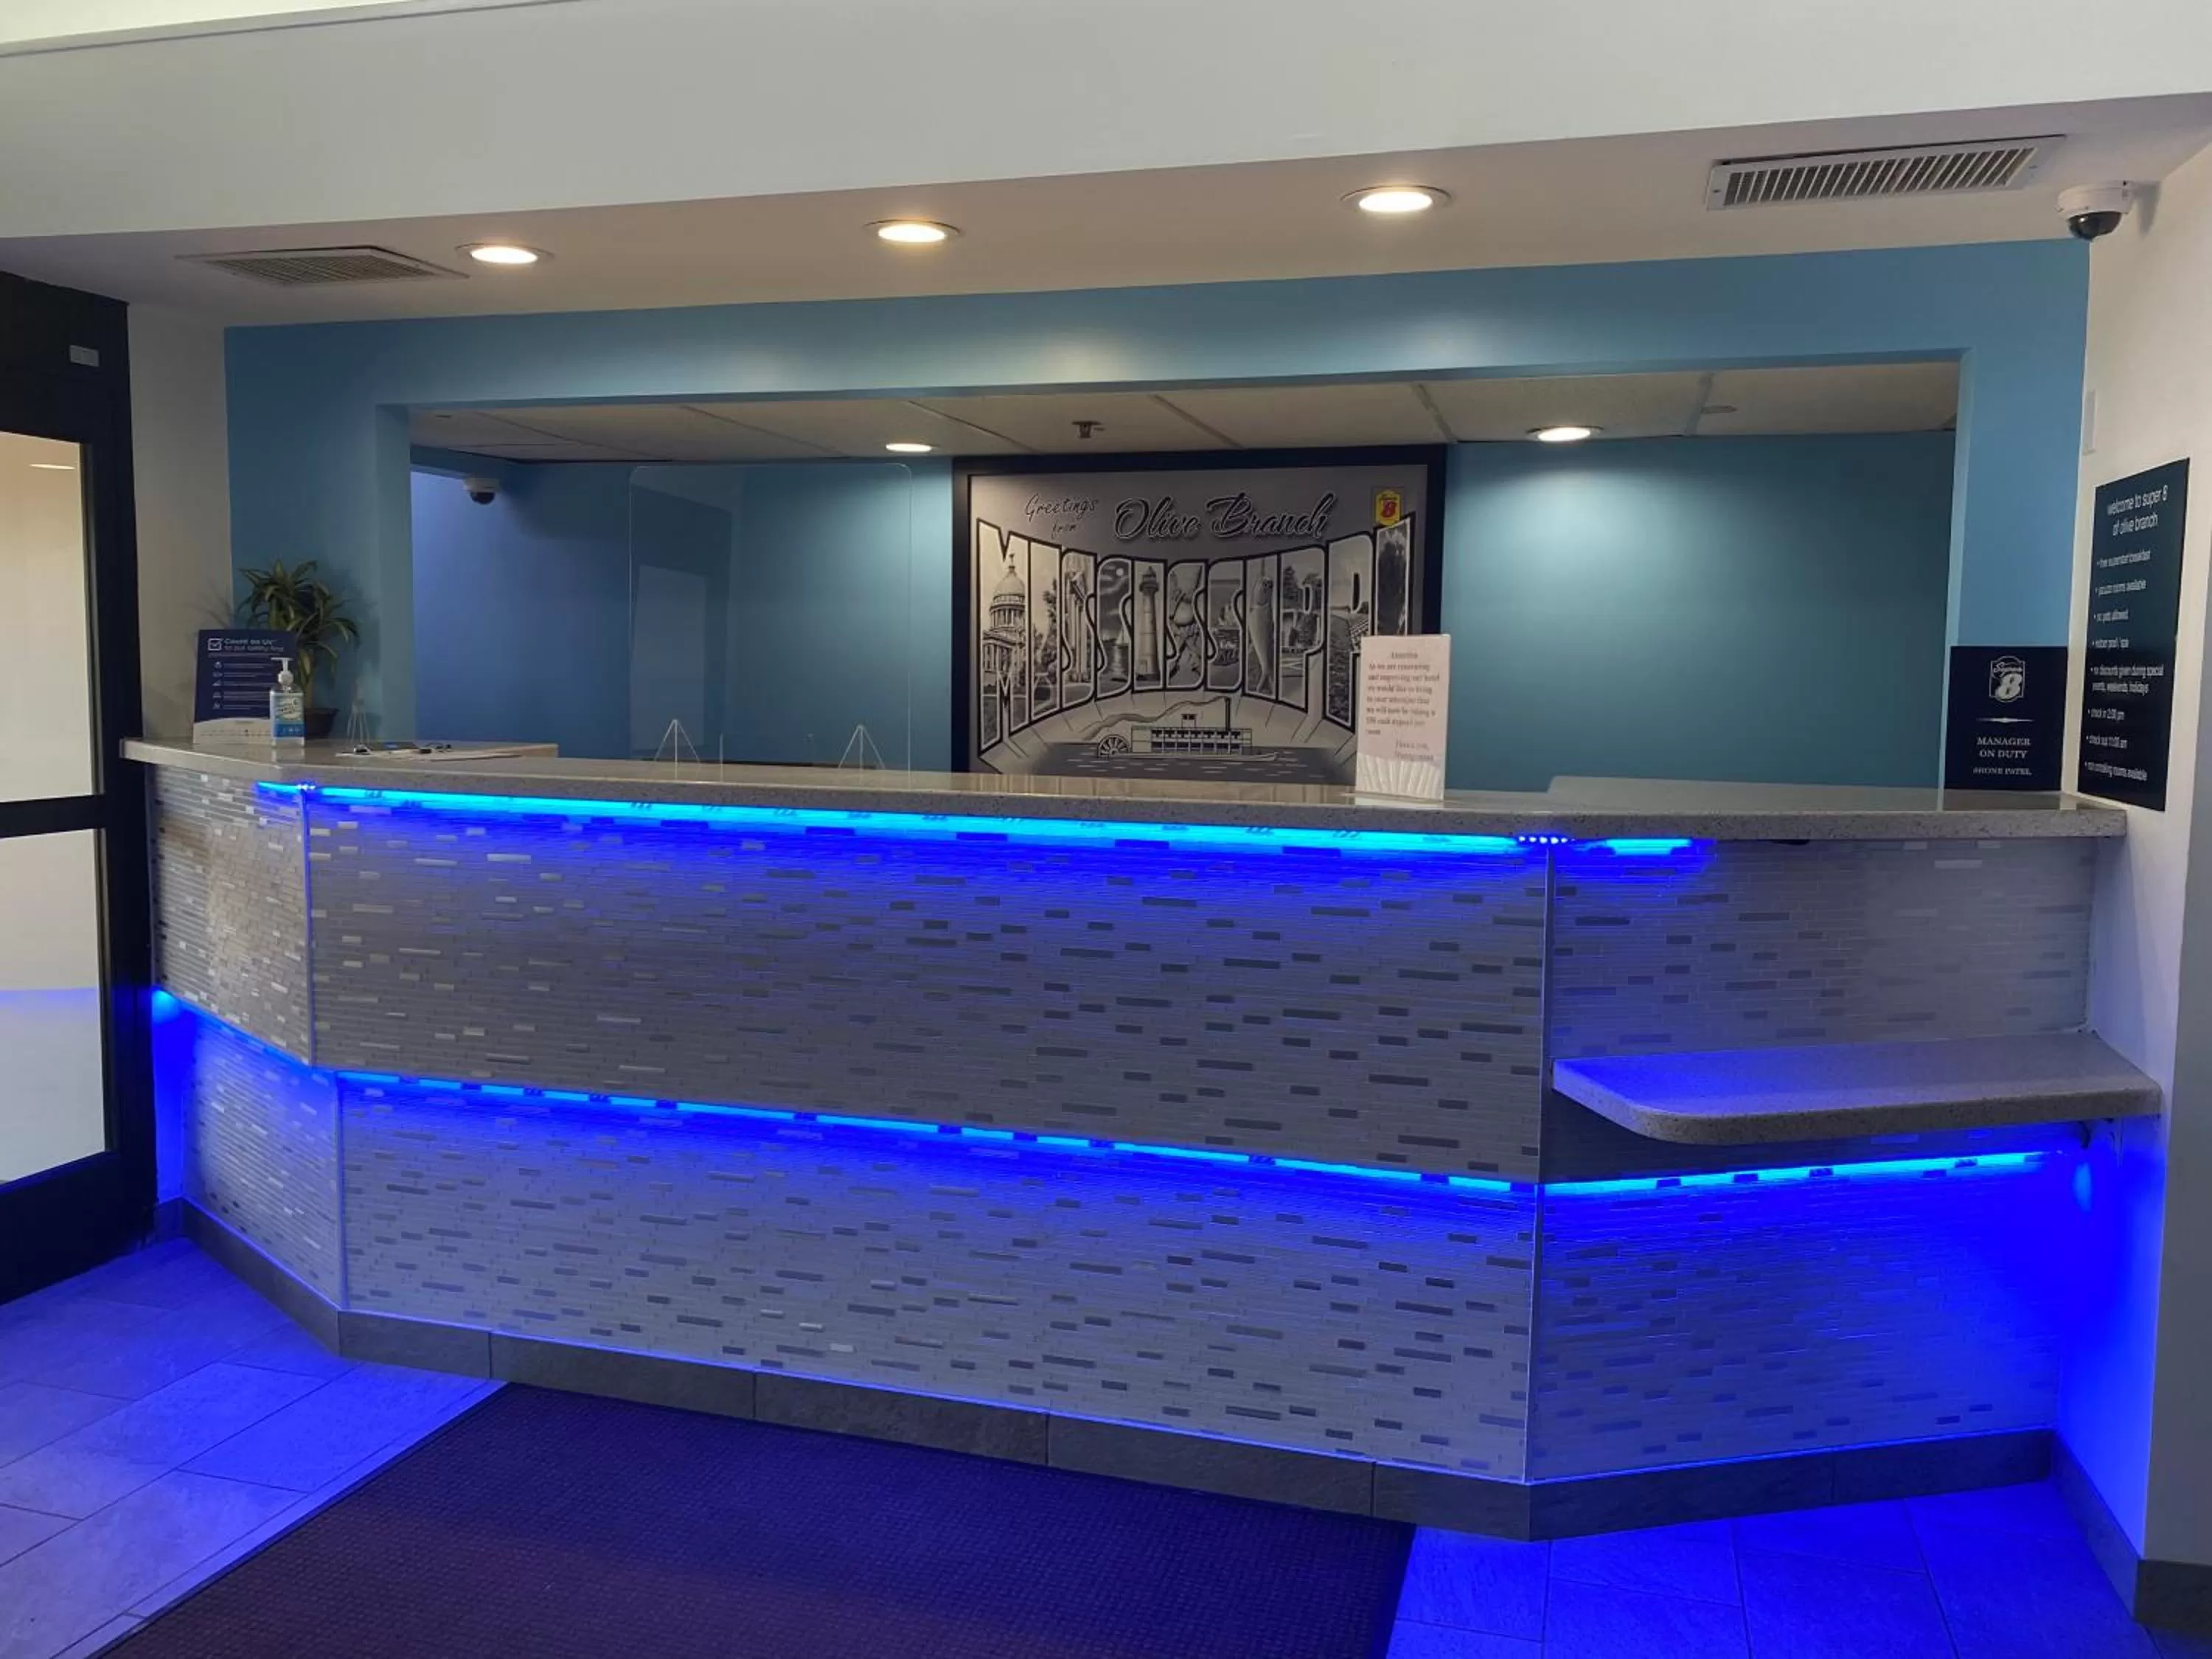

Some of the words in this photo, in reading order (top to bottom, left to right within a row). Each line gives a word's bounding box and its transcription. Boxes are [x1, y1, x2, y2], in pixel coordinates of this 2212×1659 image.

[1025, 493, 1098, 522] Greetings
[2107, 498, 2134, 515] welcome
[2135, 493, 2141, 508] to
[2142, 489, 2162, 508] super
[2163, 484, 2168, 501] 8
[1051, 518, 1077, 539] from
[1113, 496, 1202, 540] Olive
[1205, 492, 1336, 538] Branch
[2112, 519, 2119, 535] of
[2120, 518, 2134, 535] olive
[2135, 512, 2159, 531] branch
[1994, 672, 2023, 700] 8
[1976, 737, 2031, 746] MANAGER
[1979, 749, 1995, 758] ON
[1997, 750, 2028, 759] DUTY
